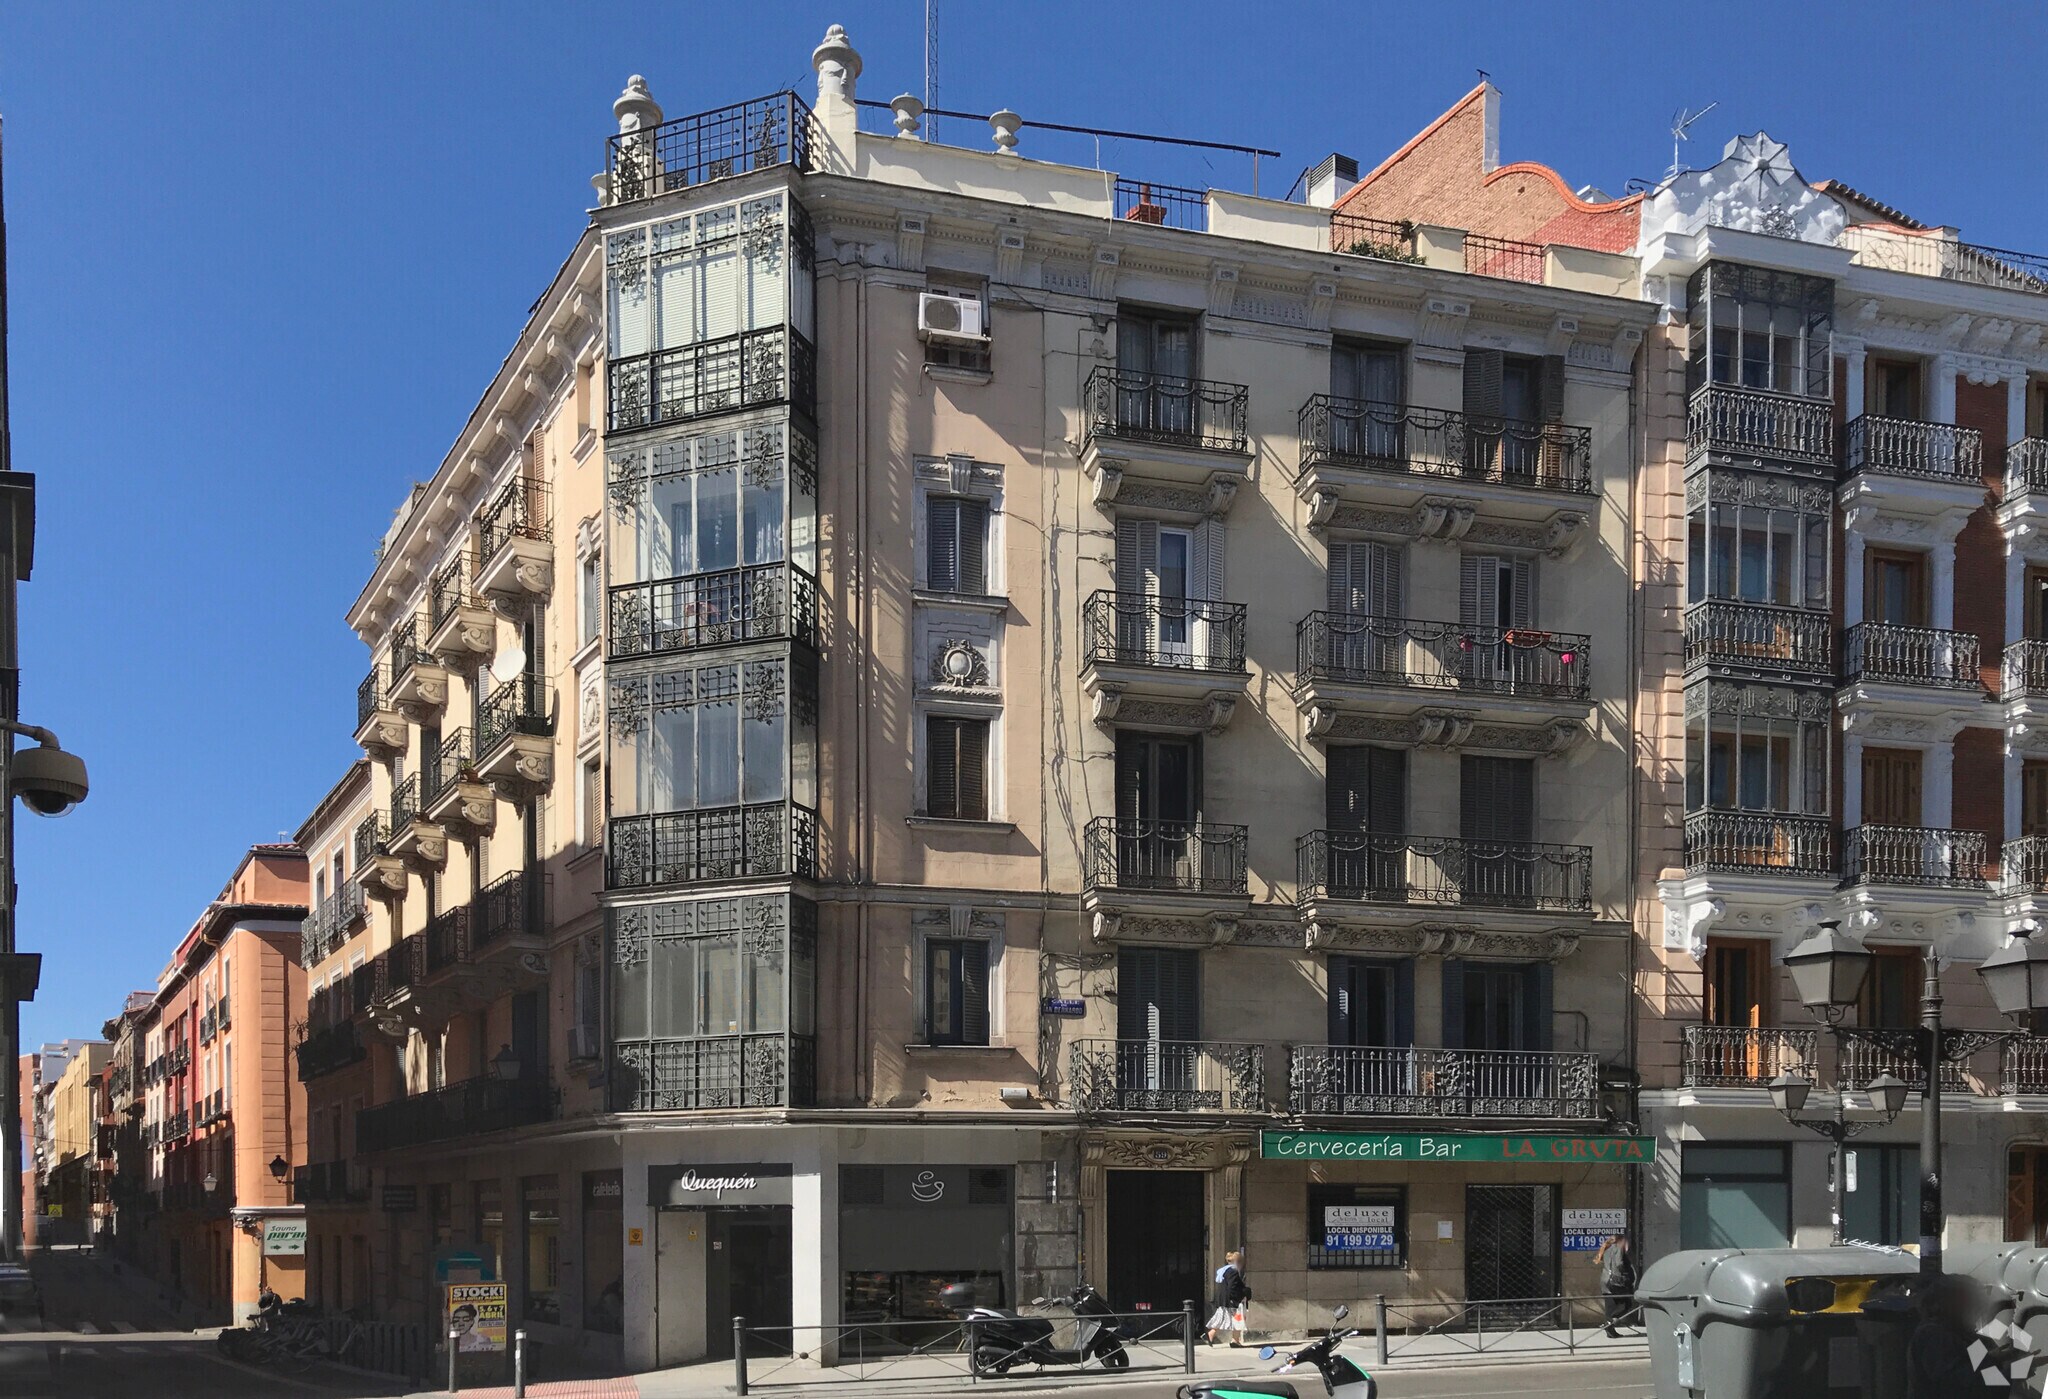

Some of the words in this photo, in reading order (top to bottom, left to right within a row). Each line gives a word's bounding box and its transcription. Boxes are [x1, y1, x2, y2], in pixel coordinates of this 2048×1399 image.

[1277, 1135, 1402, 1157] Cervecería
[1419, 1137, 1461, 1157] Bar
[1502, 1138, 1536, 1158] LA
[681, 1168, 757, 1200] Quequén
[1332, 1208, 1388, 1216] deluxe
[1326, 1234, 1339, 1246] 91
[1343, 1234, 1362, 1246] 199
[1365, 1234, 1378, 1246] 97
[1380, 1234, 1394, 1246] 29
[1563, 1235, 1575, 1247] 91
[1579, 1235, 1596, 1247] 199
[453, 1287, 503, 1297] STOCK!
